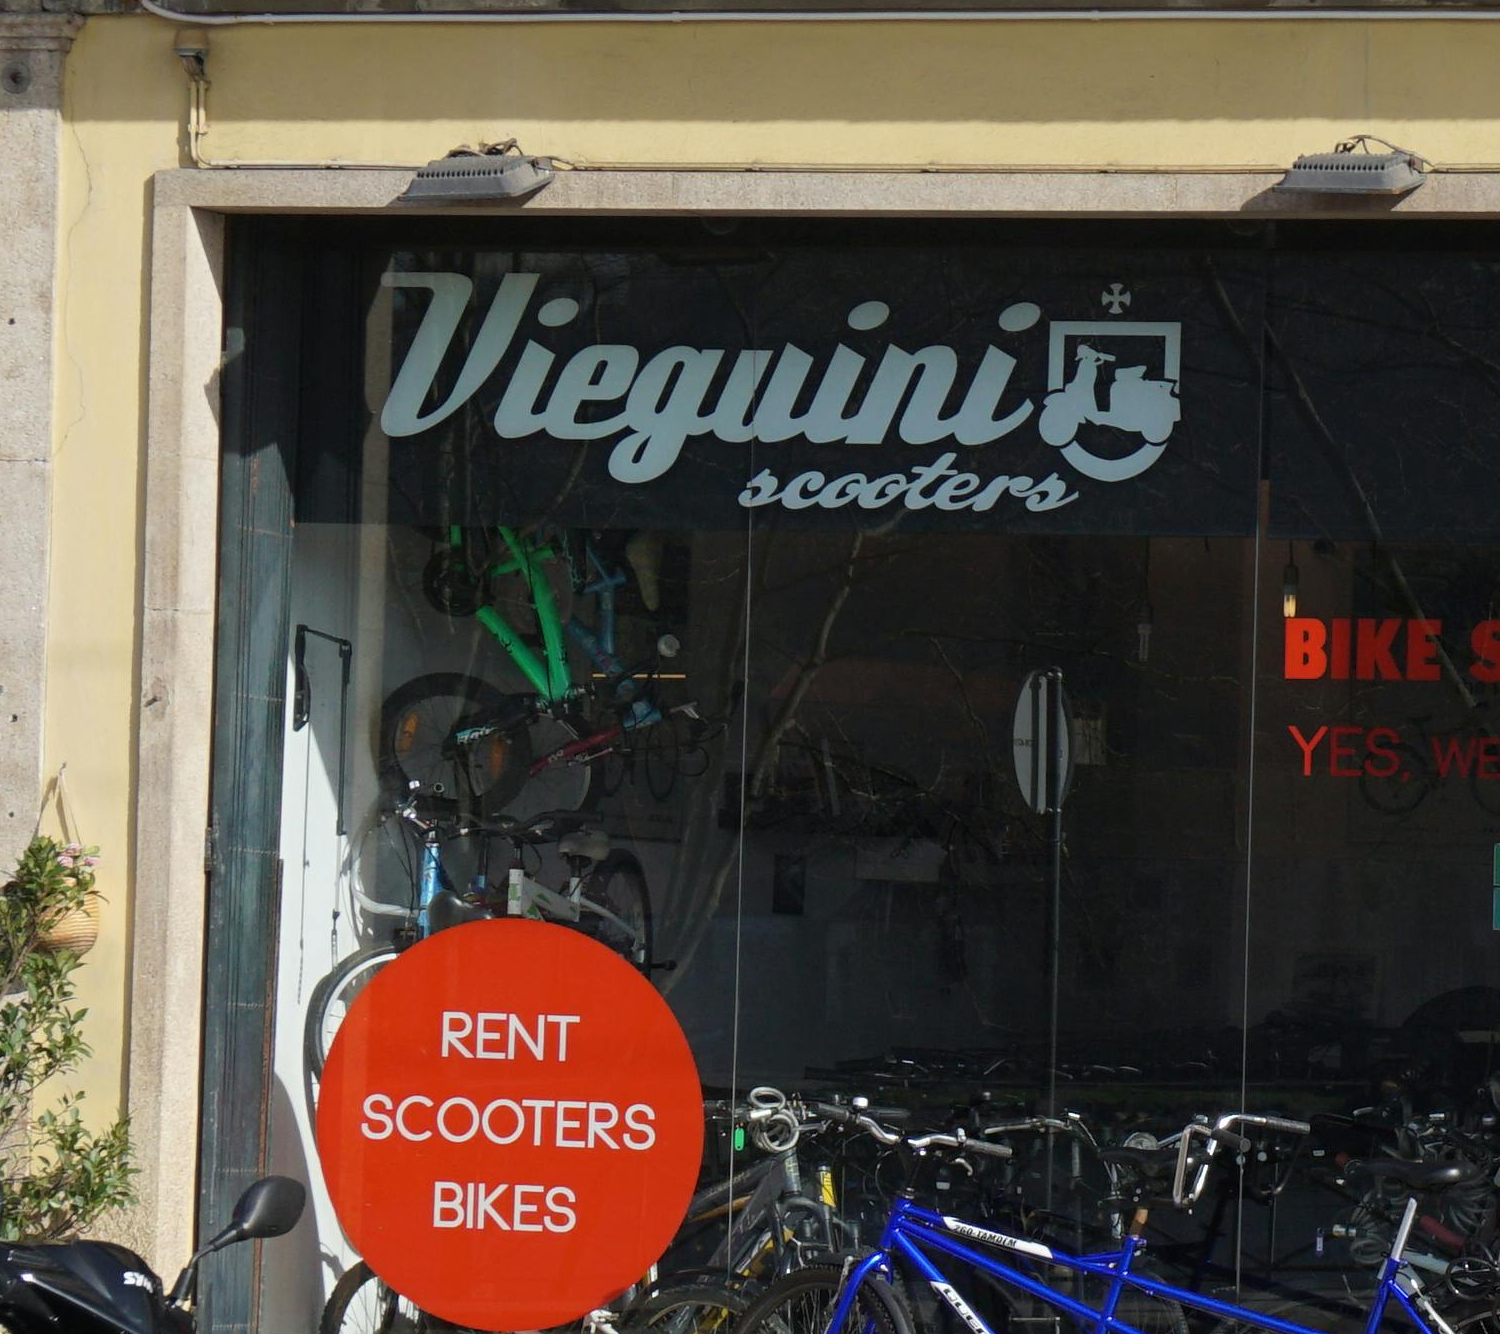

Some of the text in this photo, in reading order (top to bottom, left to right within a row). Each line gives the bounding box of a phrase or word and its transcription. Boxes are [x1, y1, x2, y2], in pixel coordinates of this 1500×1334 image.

[380, 271, 1041, 485] Vieguini
[738, 451, 1081, 513] scooters
[1284, 617, 1443, 681] BIKE
[1287, 725, 1411, 782] YES,
[441, 1011, 581, 1062] RENT
[360, 1093, 656, 1150] SCOOTERS
[433, 1180, 577, 1234] BIKES
